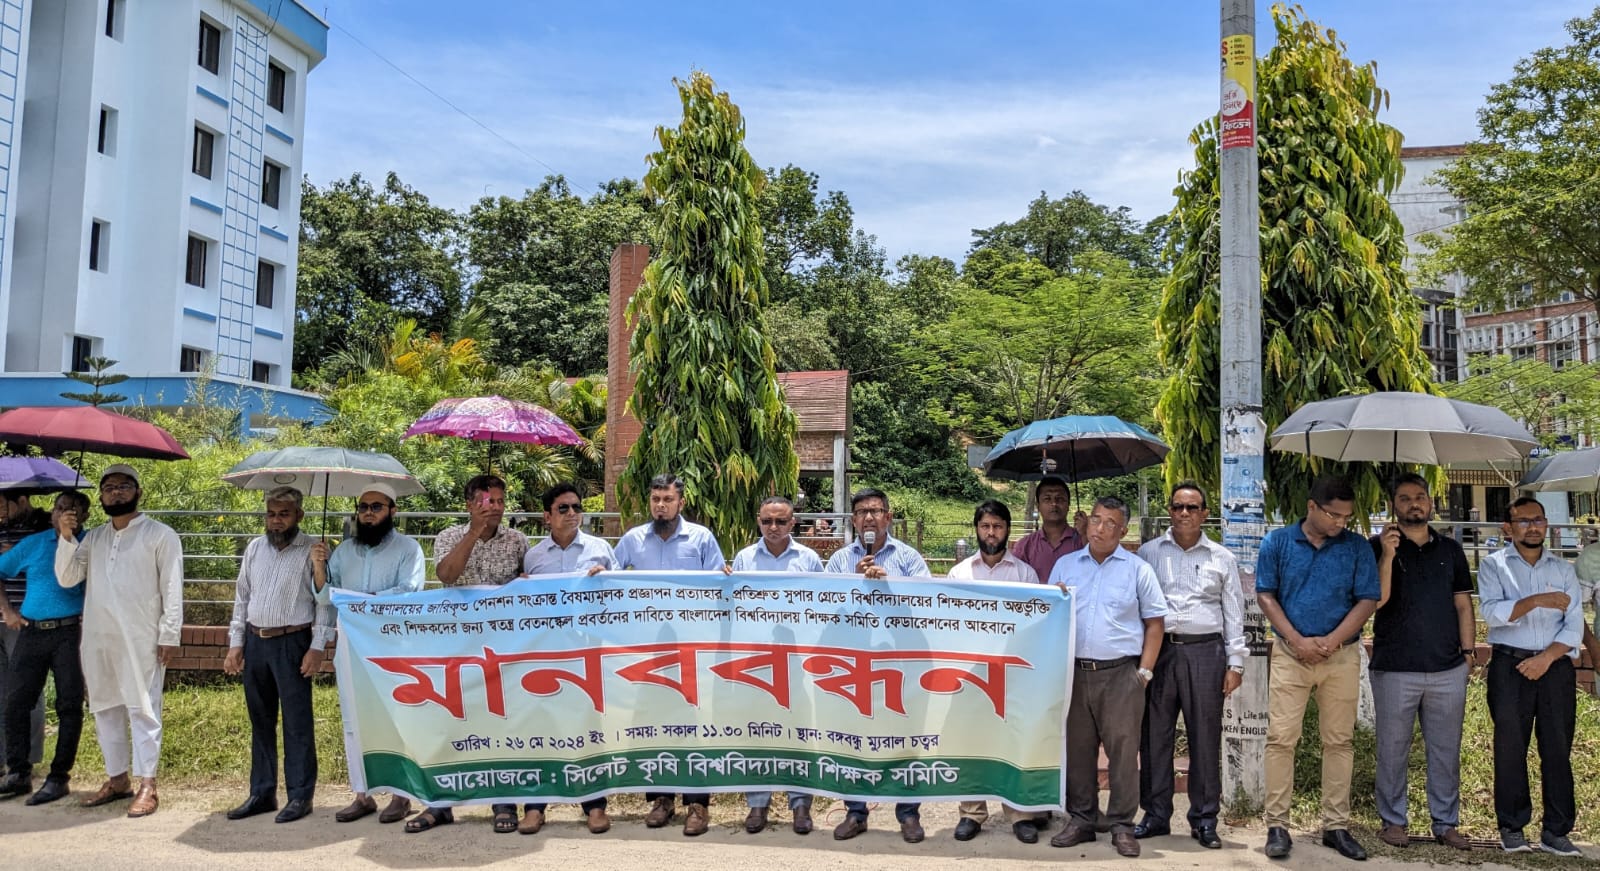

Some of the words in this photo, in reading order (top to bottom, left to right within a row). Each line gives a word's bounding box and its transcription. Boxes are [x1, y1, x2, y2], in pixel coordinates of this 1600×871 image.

[348, 600, 367, 614] অর্থ
[427, 600, 468, 617] জারিকৃত
[473, 596, 513, 611] পেনশন
[518, 593, 557, 607] সংক্রান্ত
[560, 589, 624, 606] বৈষম্যমূলক
[629, 588, 671, 599] প্রজ্ঞাপন
[784, 590, 813, 603] সুপার
[818, 590, 846, 603] গ্রেডে
[851, 589, 932, 607] বিশ্ববিদ্যালয়ের
[937, 593, 998, 611] শিক্ষকদের
[381, 624, 401, 635] এবং
[404, 621, 456, 634] শিক্ষকদের
[461, 622, 483, 634] জন্য
[579, 608, 629, 626] প্রবর্তনের
[633, 606, 673, 622] দাবিতে
[678, 610, 731, 621] বাংলাদেশ
[735, 606, 801, 623] বিশ্ববিদ্যালয়
[804, 609, 841, 624] শিক্ষক
[844, 612, 879, 627] সমিতি
[885, 617, 960, 630] ফেডারেশনের
[366, 641, 1034, 722] মানববন্ধন
[452, 735, 490, 751] তারিখ
[506, 737, 524, 749] ২৬
[530, 737, 543, 748] মে
[549, 736, 584, 750] ২০২৪
[589, 731, 605, 744] ইং
[662, 724, 698, 737] সকাল
[703, 725, 742, 737] ১১.৩০
[748, 722, 782, 737] মিনিট
[826, 730, 863, 751] বঙ্গবন্ধু
[867, 736, 905, 751] ম্যুরাল
[910, 735, 939, 750] চত্বর
[433, 768, 543, 792] আয়োজনে
[563, 756, 629, 786] সিলেট
[636, 752, 680, 784] কৃষি
[686, 751, 812, 778] বিশ্ববিদ্যালয়
[816, 756, 884, 787] শিক্ষক
[889, 761, 961, 787] সমিতি
